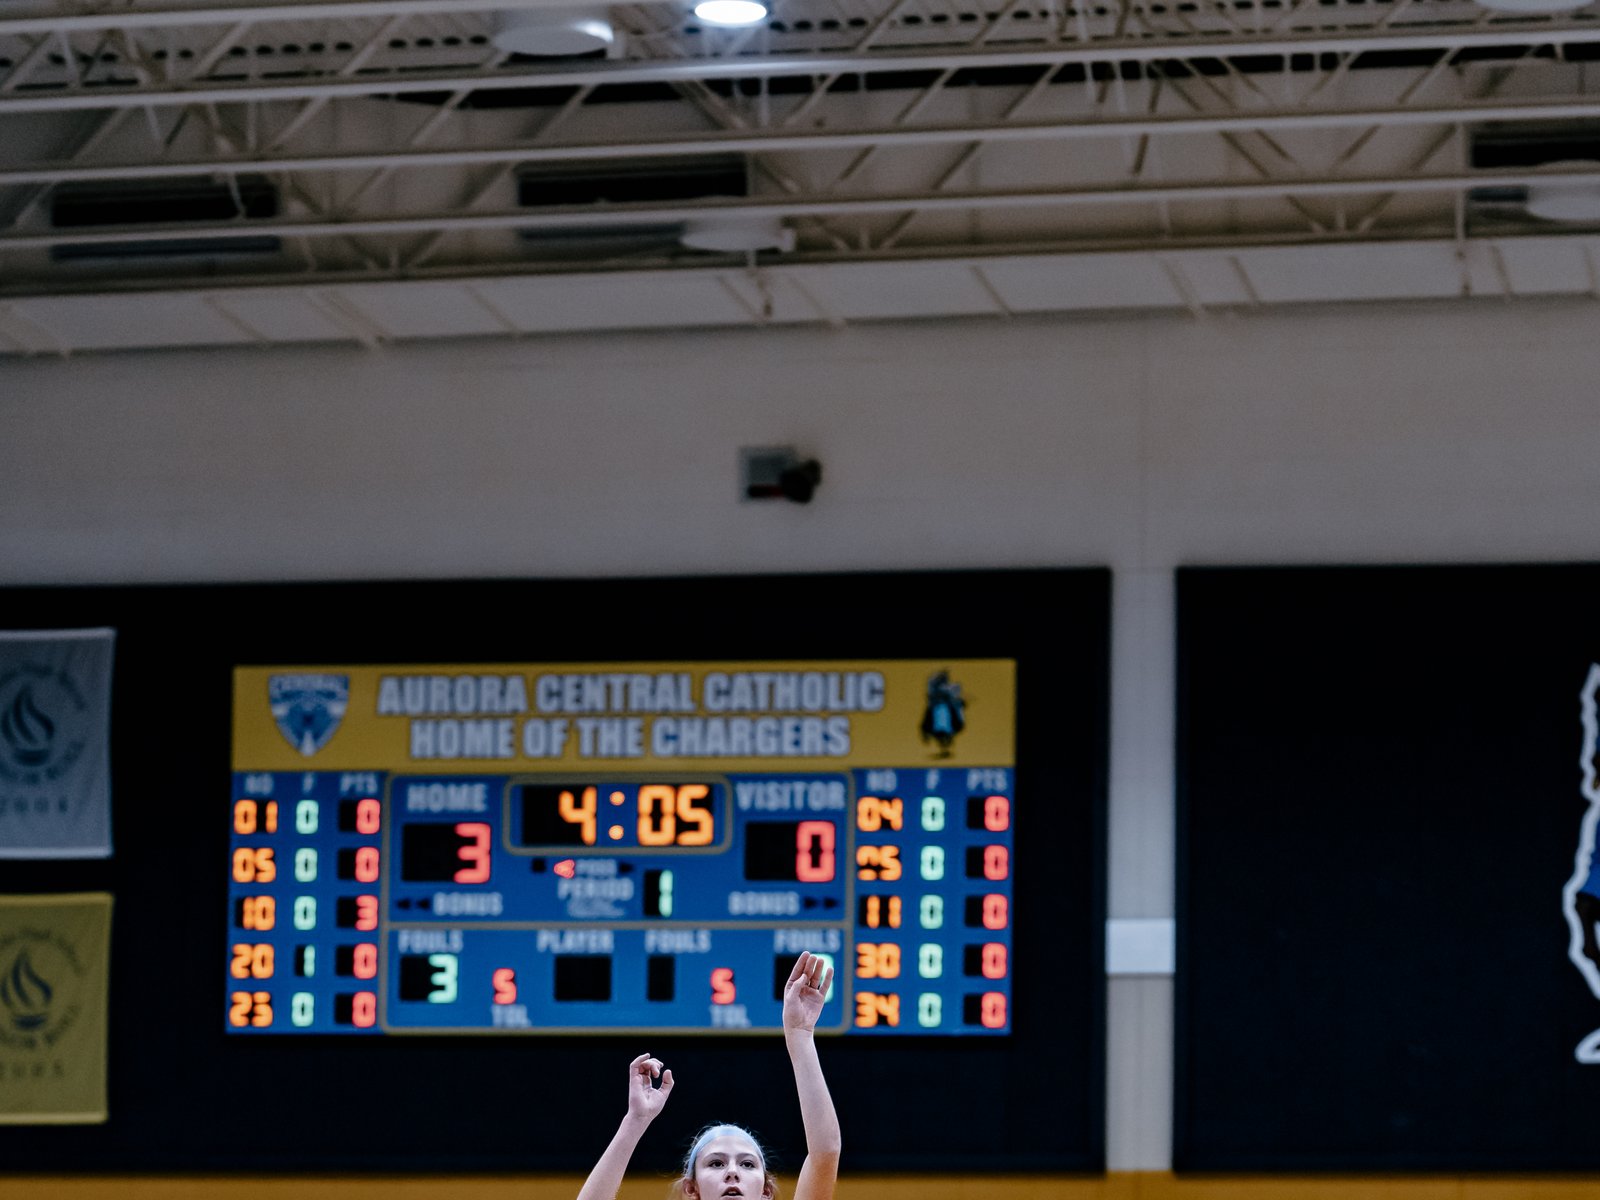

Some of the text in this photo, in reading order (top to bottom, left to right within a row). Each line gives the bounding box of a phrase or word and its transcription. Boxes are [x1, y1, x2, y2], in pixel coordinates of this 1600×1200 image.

[377, 671, 885, 716] AURORA CENTRAL CATHOLIC
[409, 716, 851, 759] HOME OF THE CHARGERS
[340, 773, 378, 793] PTS
[407, 783, 488, 812] HOME
[736, 781, 845, 811] VISITOR
[967, 770, 1007, 791] PTS
[233, 799, 381, 835] 01 0 0
[558, 784, 714, 847] 4:05
[856, 795, 1010, 832] 04 0 0
[232, 846, 380, 883] 05 0 0
[454, 823, 491, 884] 3
[796, 820, 835, 883] 0
[920, 845, 945, 881] 0
[983, 845, 1009, 881] 0
[433, 892, 503, 916] BONUS
[557, 878, 634, 900] PERIOD
[658, 870, 674, 918] 1
[728, 891, 800, 916] BONUS
[242, 894, 379, 931] 10 0 3
[866, 893, 1008, 930] 11 0 0
[398, 930, 464, 952] FOULS
[537, 930, 614, 952] PLAYER
[645, 930, 711, 952] FOULS
[774, 929, 841, 952] FOULS
[230, 943, 378, 979] 20 1 0
[428, 954, 458, 1003] 3
[856, 942, 901, 979] 30
[919, 942, 943, 979] 0
[981, 942, 1007, 979] 0
[291, 991, 315, 1027] 0
[352, 991, 377, 1028] 0
[855, 991, 1007, 1029] 34 0 0
